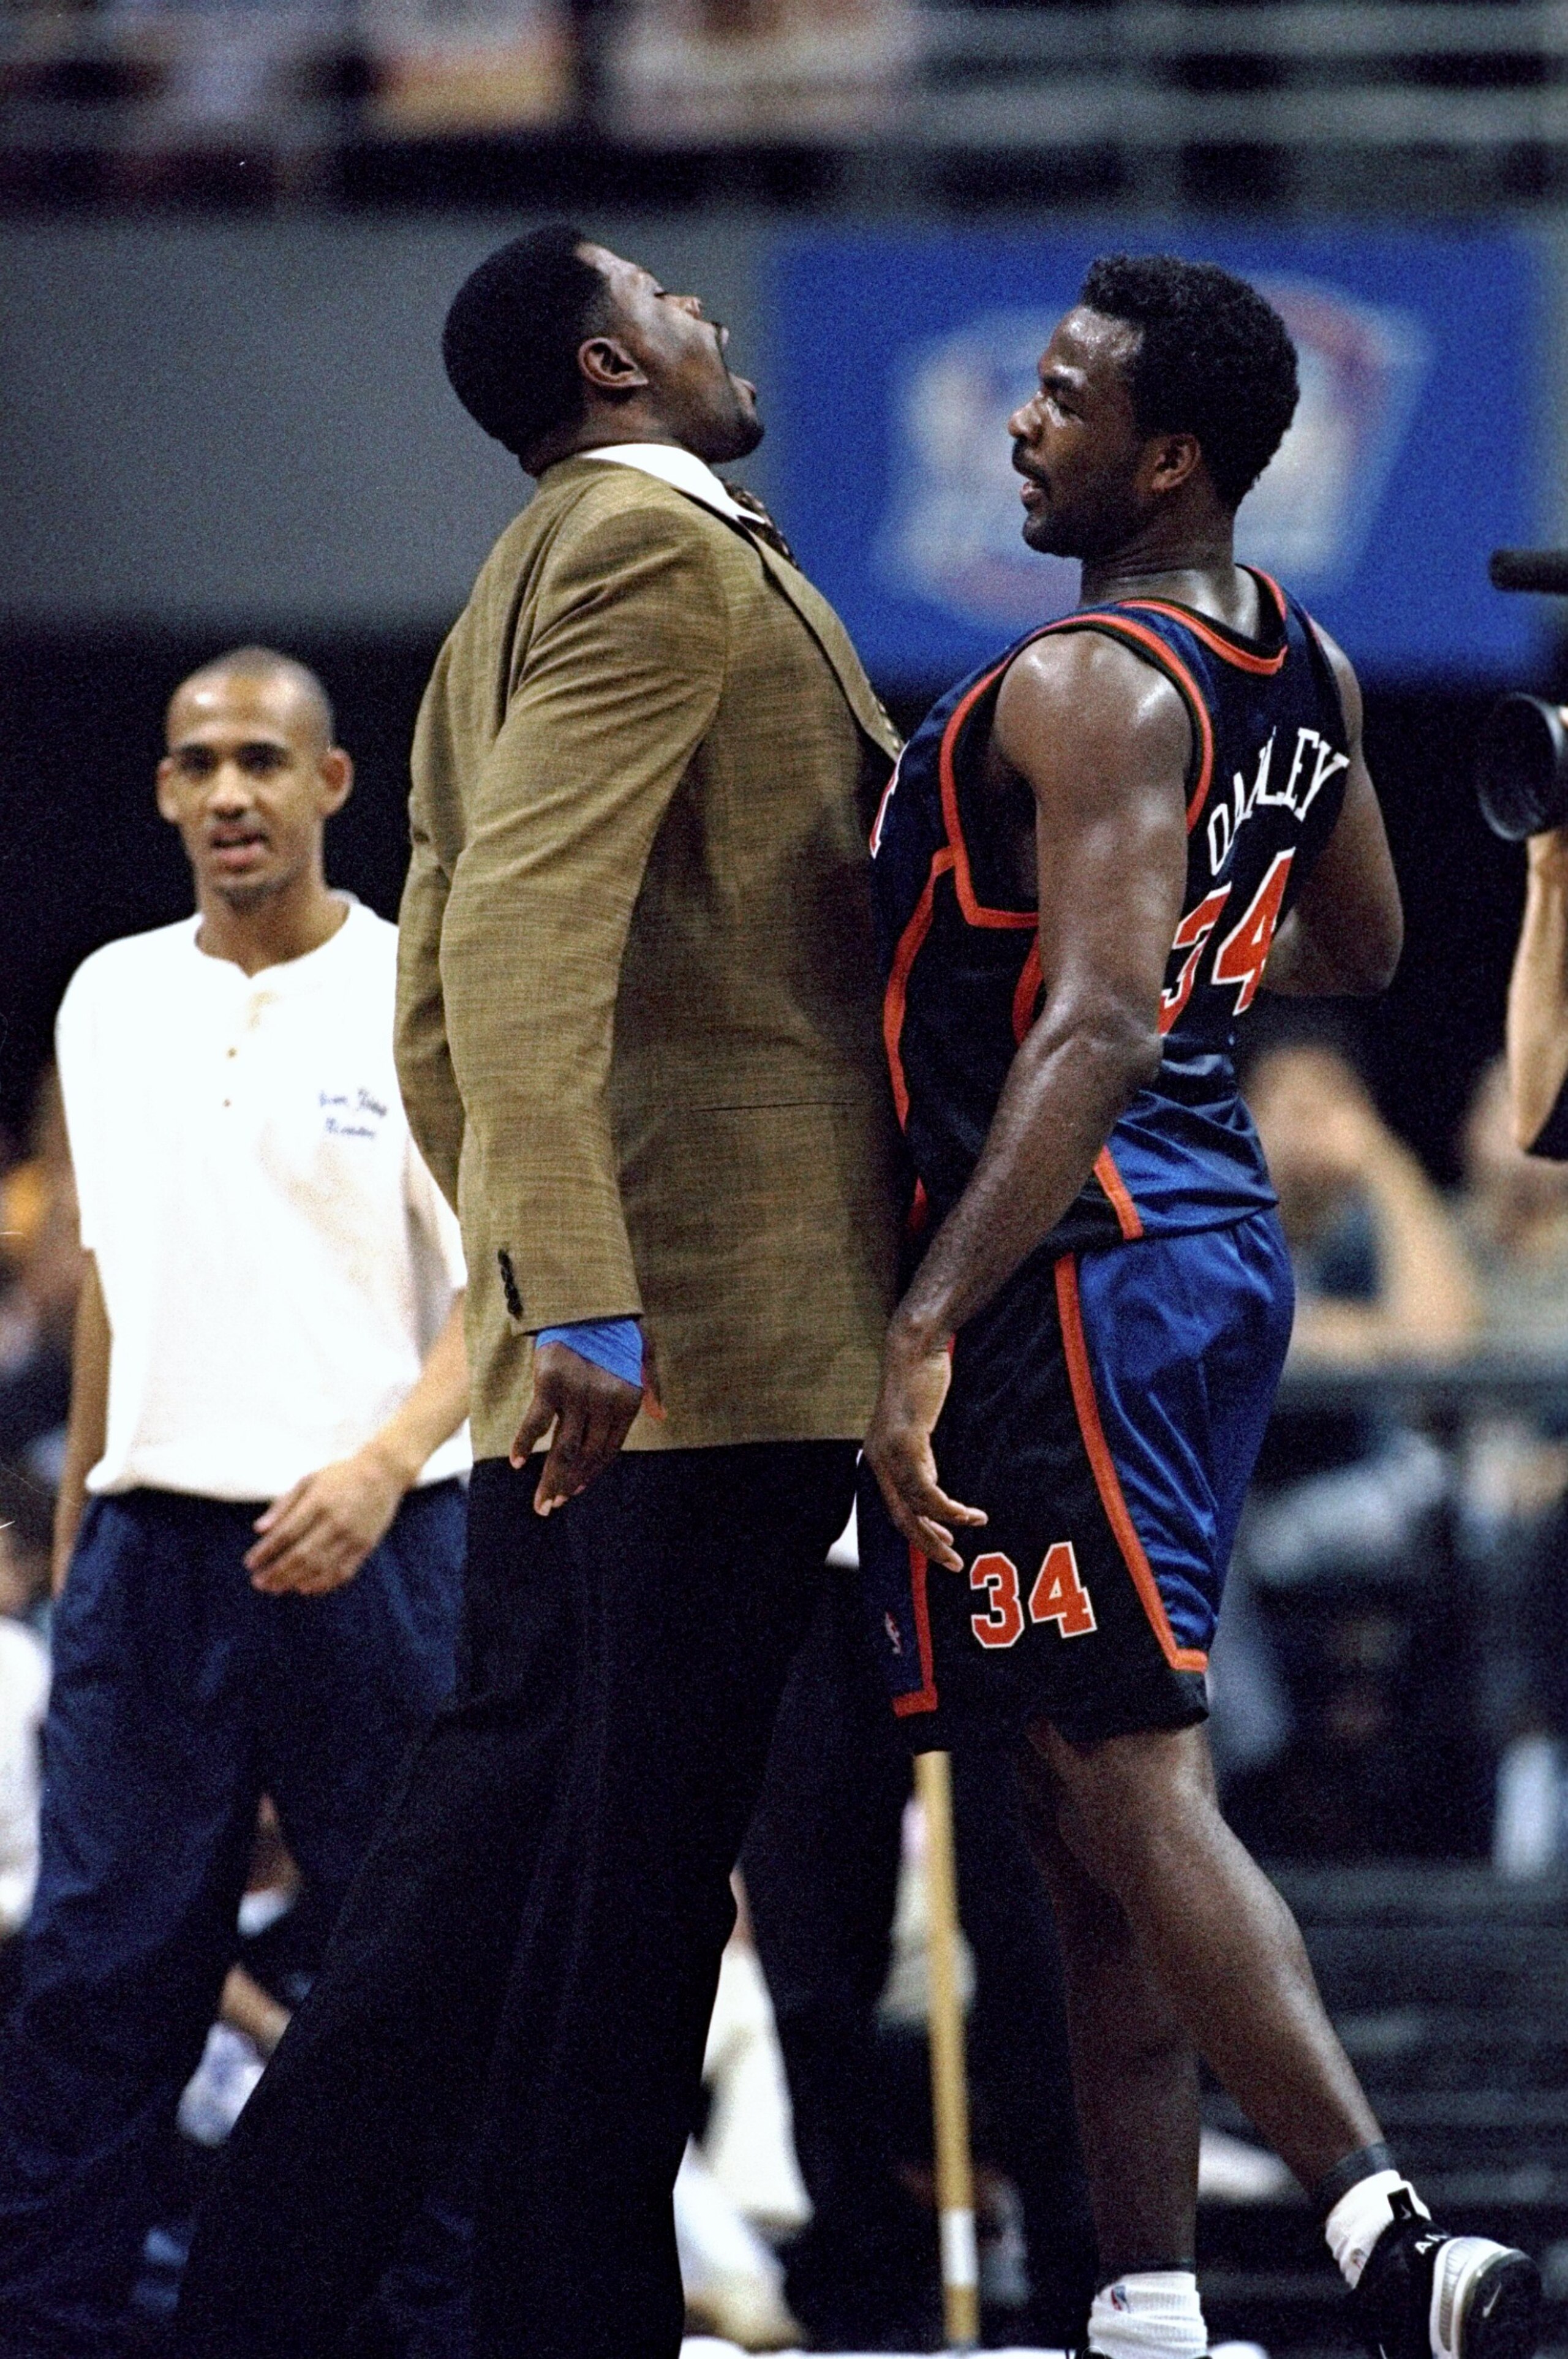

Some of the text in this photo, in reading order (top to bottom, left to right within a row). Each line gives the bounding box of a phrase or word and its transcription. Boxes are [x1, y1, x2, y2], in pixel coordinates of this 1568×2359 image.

[1157, 847, 1296, 1036] 34
[970, 1541, 1097, 1649] 34
[1414, 2233, 1448, 2255] AI
